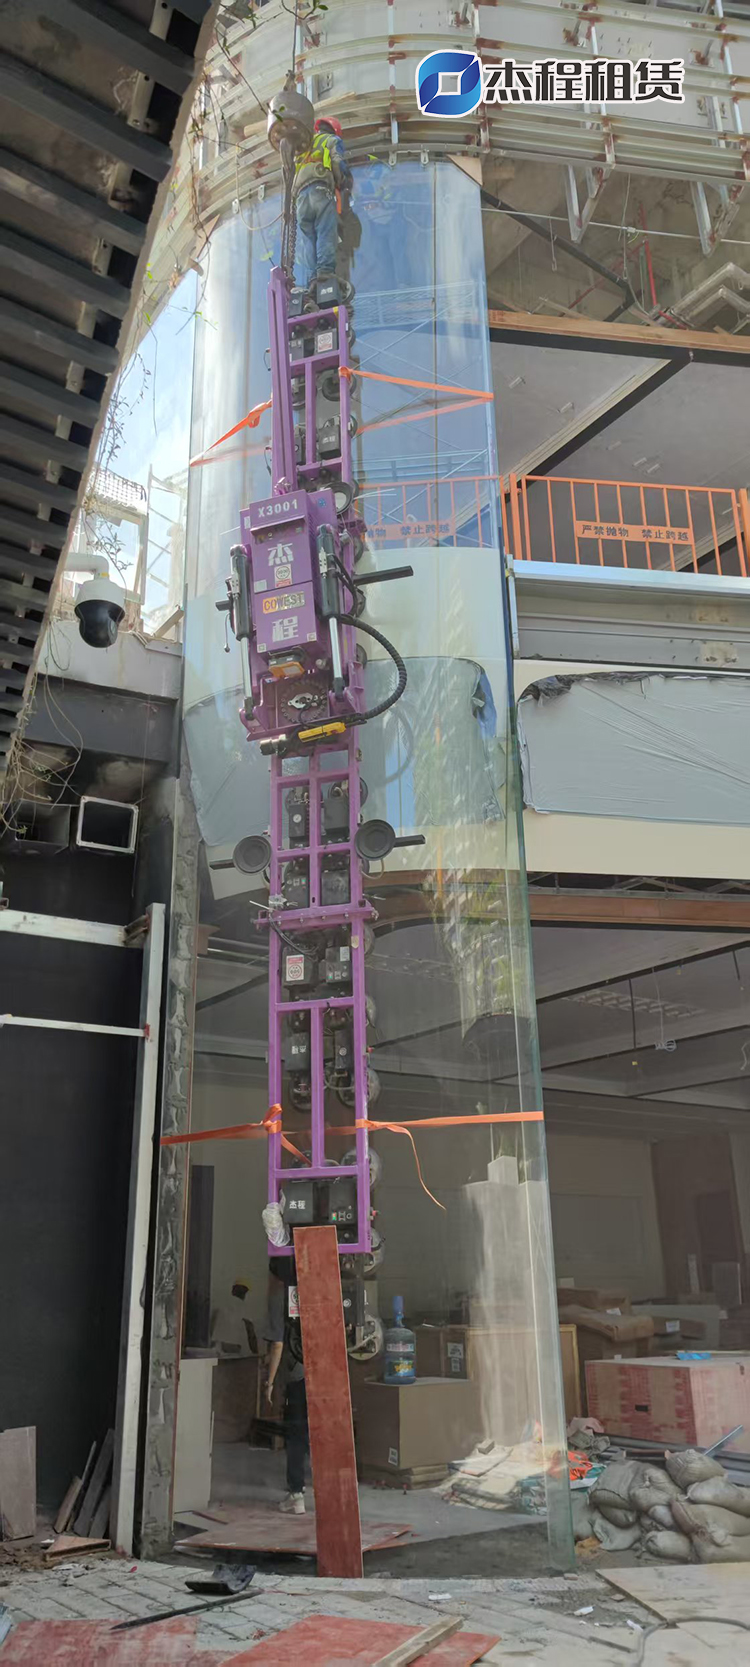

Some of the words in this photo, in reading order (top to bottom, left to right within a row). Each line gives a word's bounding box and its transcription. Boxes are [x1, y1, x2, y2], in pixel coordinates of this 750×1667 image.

[257, 499, 298, 518] X3001
[582, 525, 628, 537] 严禁抛物
[642, 529, 688, 541] 禁止跨越
[267, 542, 295, 567] 杰
[263, 590, 306, 612] COWEST
[272, 616, 298, 642] 程
